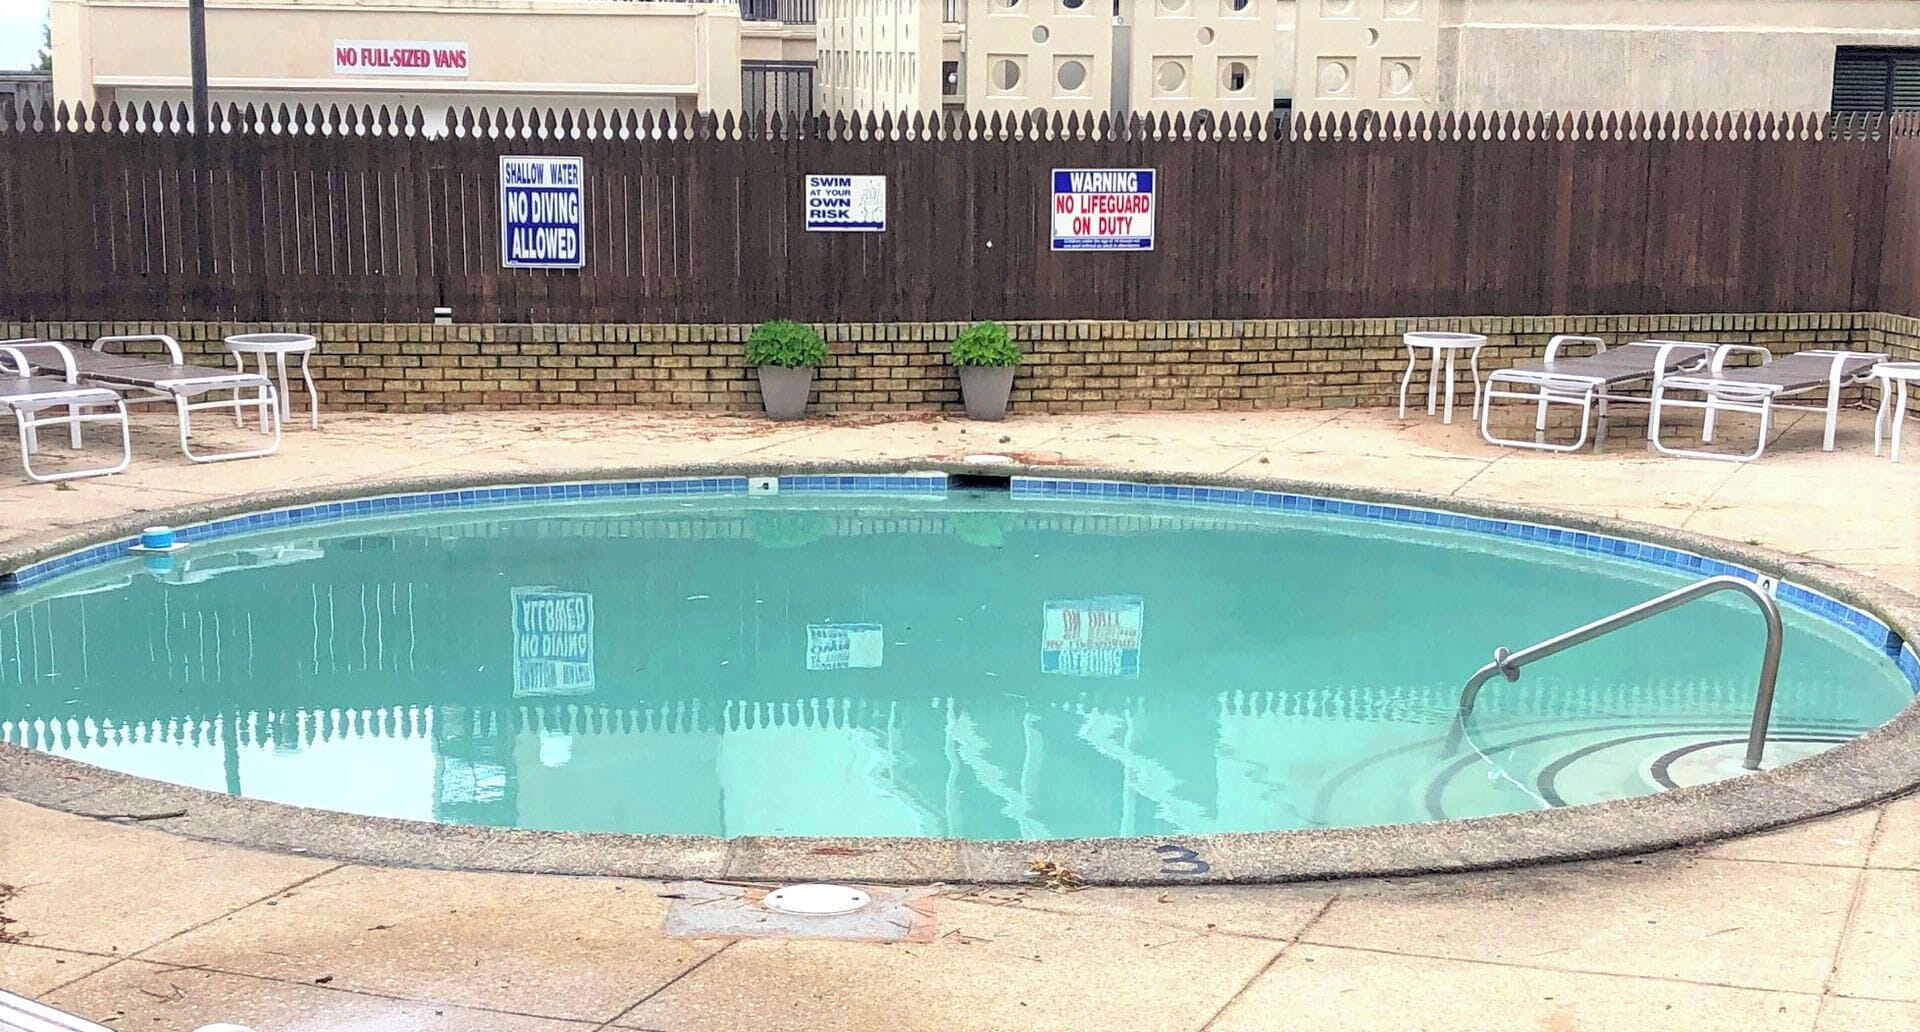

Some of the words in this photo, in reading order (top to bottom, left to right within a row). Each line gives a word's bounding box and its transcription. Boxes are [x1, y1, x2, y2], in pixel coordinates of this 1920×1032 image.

[336, 47, 357, 67] NO
[360, 48, 430, 68] FULL-SIZED
[433, 49, 467, 69] VANS
[505, 163, 544, 184] SHALLOW
[550, 164, 578, 185] WATER
[810, 177, 851, 187] SWIM
[1070, 172, 1138, 192] WARNING
[508, 191, 528, 224] NO
[531, 192, 578, 224] DIVING
[810, 198, 851, 207] OWN
[1056, 194, 1074, 214] NO
[1081, 195, 1150, 214] LIFEGUARD
[810, 209, 850, 219] RISK
[1073, 216, 1091, 235] ON
[1099, 216, 1133, 235] DUTY
[512, 227, 576, 259] ALLOWED
[1154, 844, 1211, 874] 3
